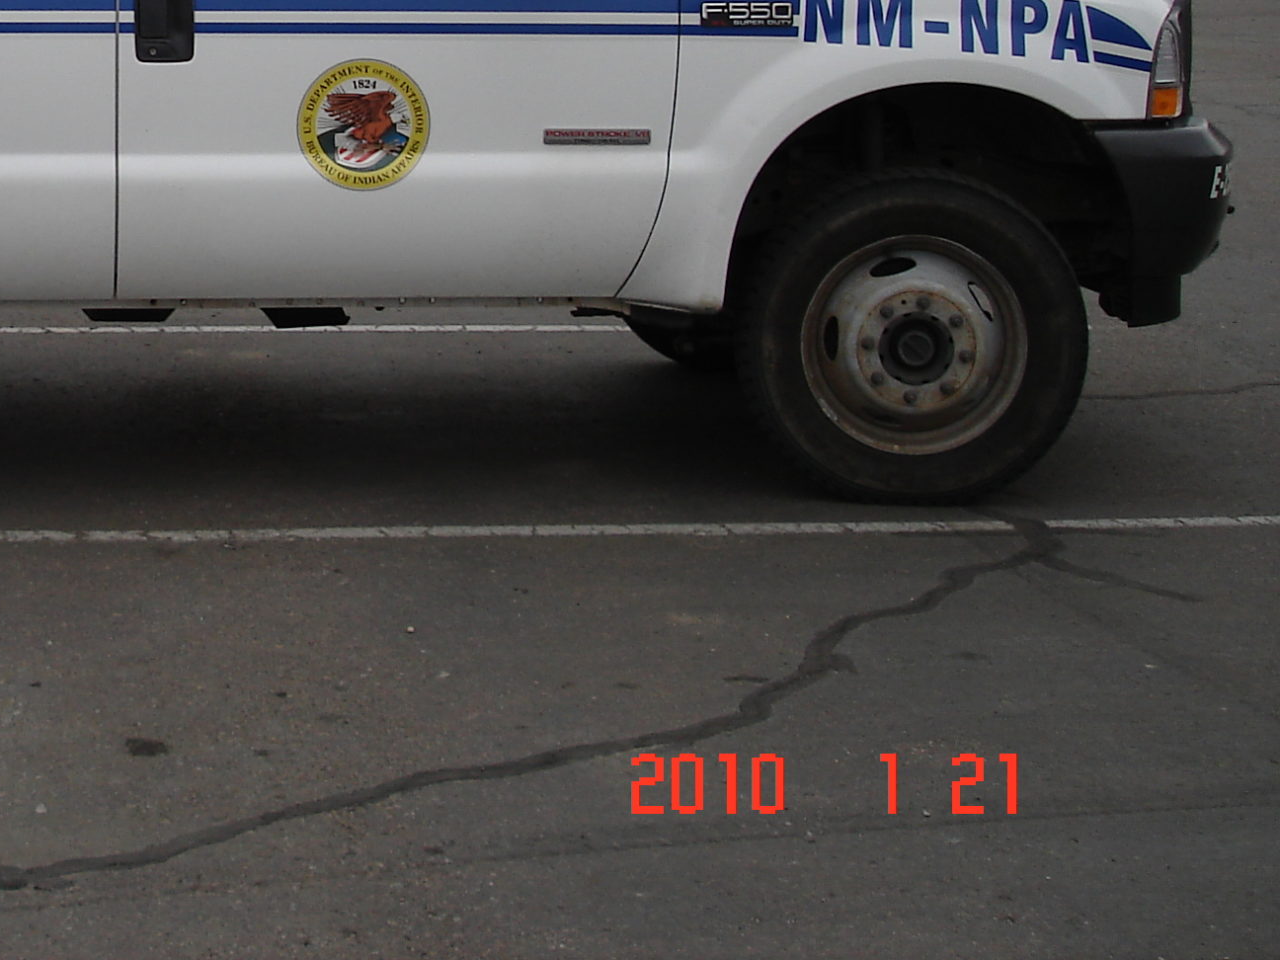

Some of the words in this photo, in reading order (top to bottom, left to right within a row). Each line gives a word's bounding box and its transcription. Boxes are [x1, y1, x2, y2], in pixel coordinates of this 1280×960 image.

[307, 65, 370, 111] DEPARTMENT
[399, 81, 424, 133] INTERIOR
[352, 80, 376, 90] 1824
[306, 140, 336, 176] BUREAU
[337, 172, 351, 184] OF
[353, 172, 390, 185] INDIAN
[390, 141, 420, 177] AFFAIRS
